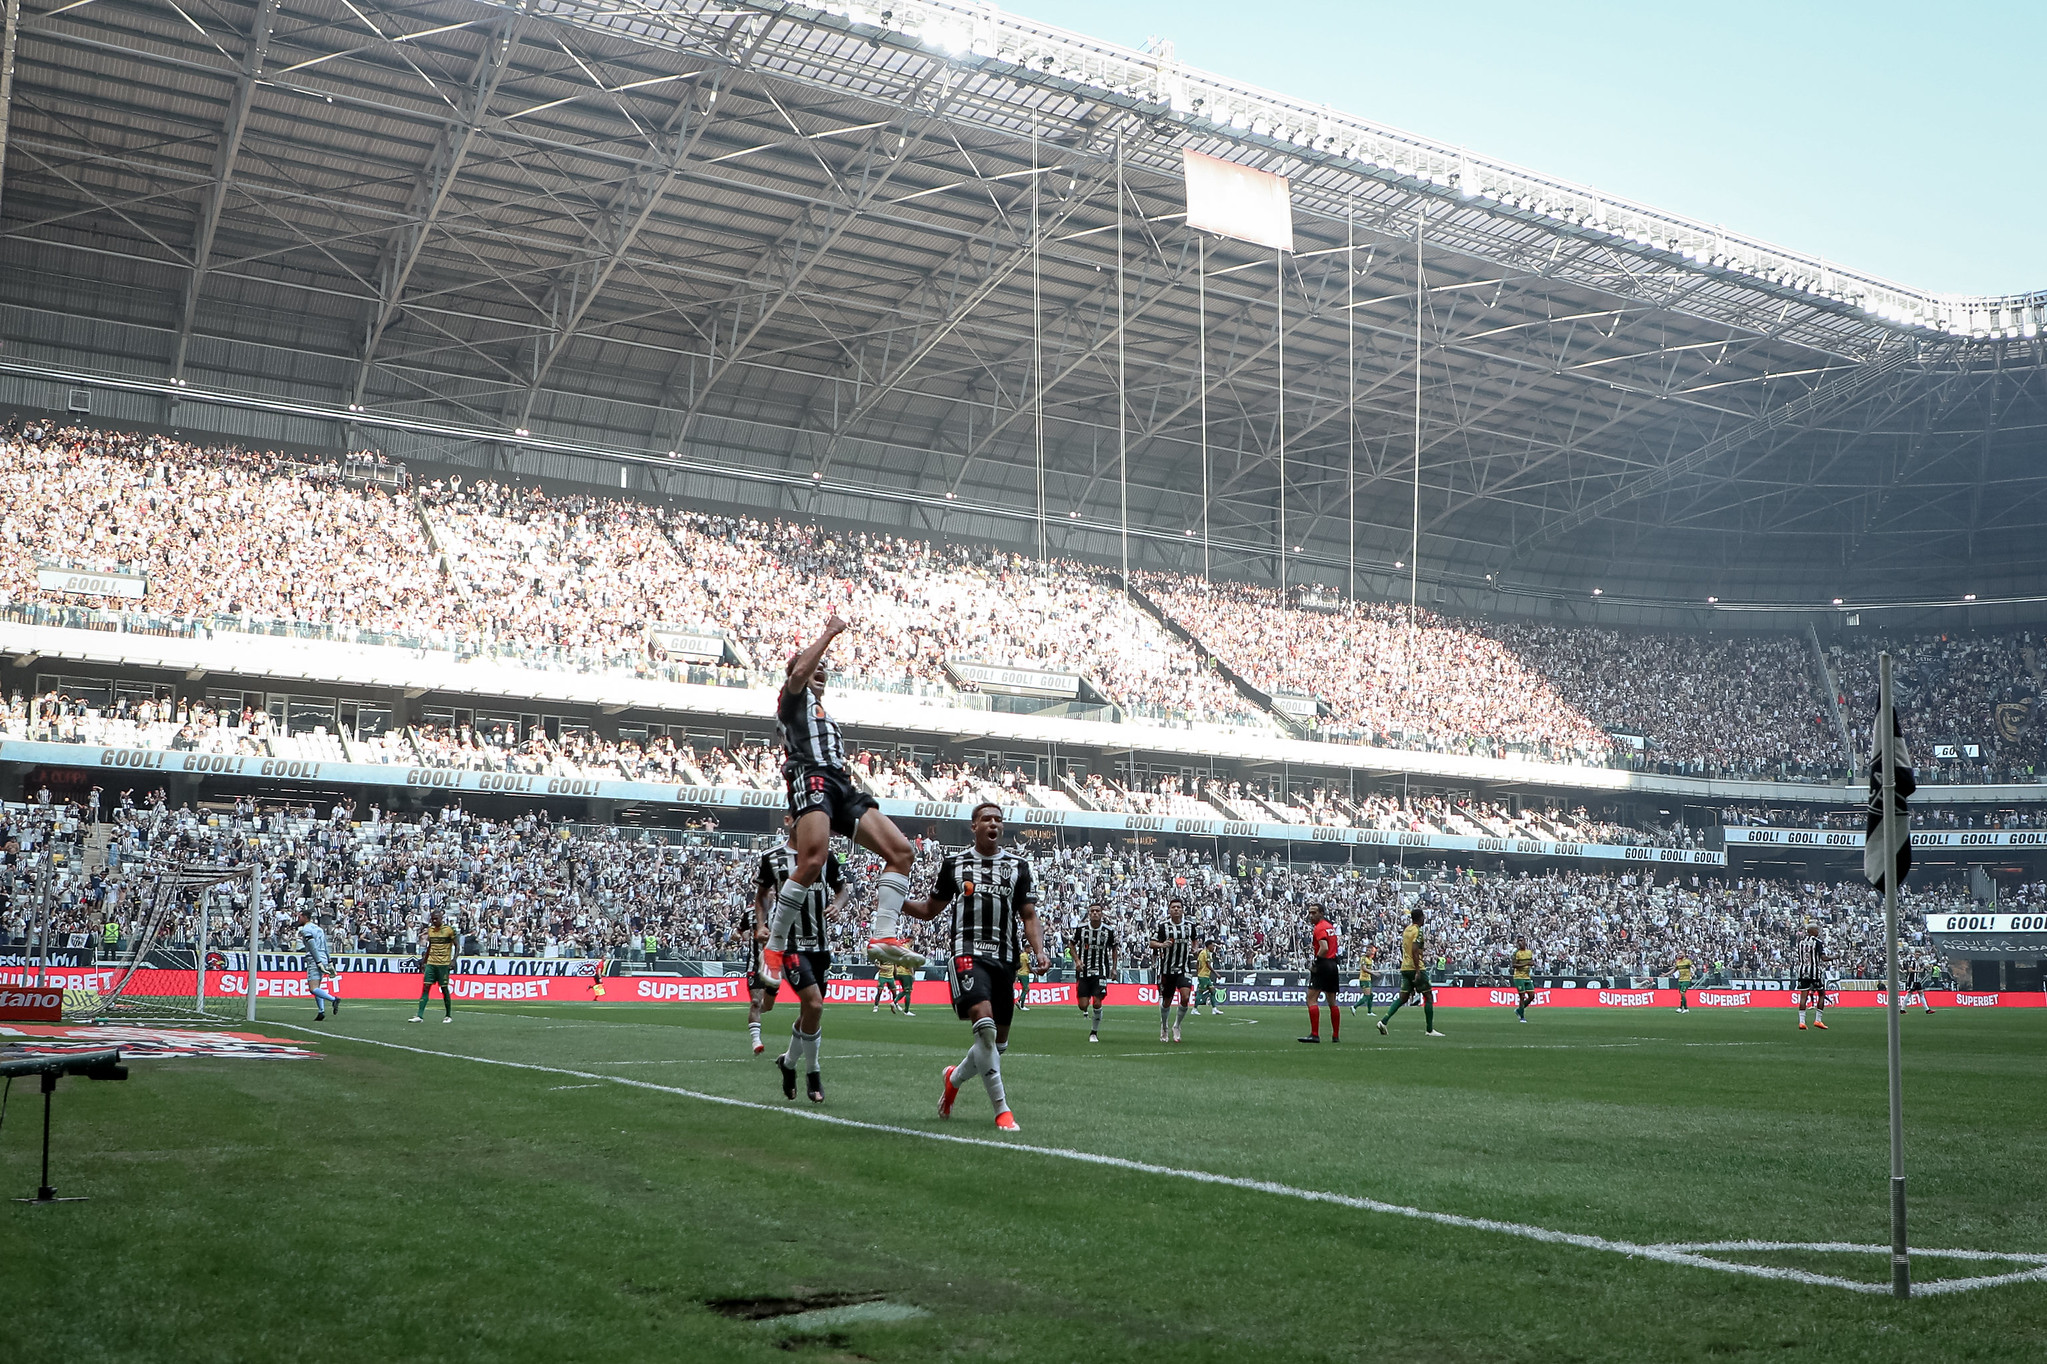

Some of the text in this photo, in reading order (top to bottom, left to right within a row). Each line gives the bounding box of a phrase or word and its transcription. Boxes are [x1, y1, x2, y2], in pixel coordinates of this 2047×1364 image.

[67, 576, 117, 593] GOOL!
[671, 637, 709, 652] GOOL!
[962, 667, 1071, 689] GOOL! GOOL! GOOL!
[101, 749, 320, 779] GOOL! GOOL! GOOL!
[407, 769, 600, 796] GOOL! GOOL! GOOL!
[677, 786, 725, 803] GOOL!
[915, 802, 958, 818] GOOL!
[1025, 809, 1066, 825] GOOL!
[1125, 816, 1259, 837] GOOL! GOOL! GOOL!
[1312, 827, 1431, 847] GOOL! GOOL! GOOL!
[1749, 831, 1856, 845] GOOL! GOOL! GOOL!
[1912, 833, 2047, 845] GOOL! GOOL! GOOL!
[1478, 837, 1583, 856] GOOL! GOOL! GOOL!
[1625, 847, 1720, 864] GOOL! GOOL! GOOL!
[975, 883, 1012, 897] BETANO
[1946, 916, 1995, 930] GOOL!
[1943, 944, 2001, 952] NOSSA
[637, 980, 739, 1000] SUPERBET
[1229, 990, 1327, 1002] BRASILEIRO
[0, 990, 60, 1008] tano
[1598, 991, 1655, 1007] SUPERBET
[1699, 991, 1751, 1007] SUPERBET
[1956, 993, 1999, 1007] SUPERBET
